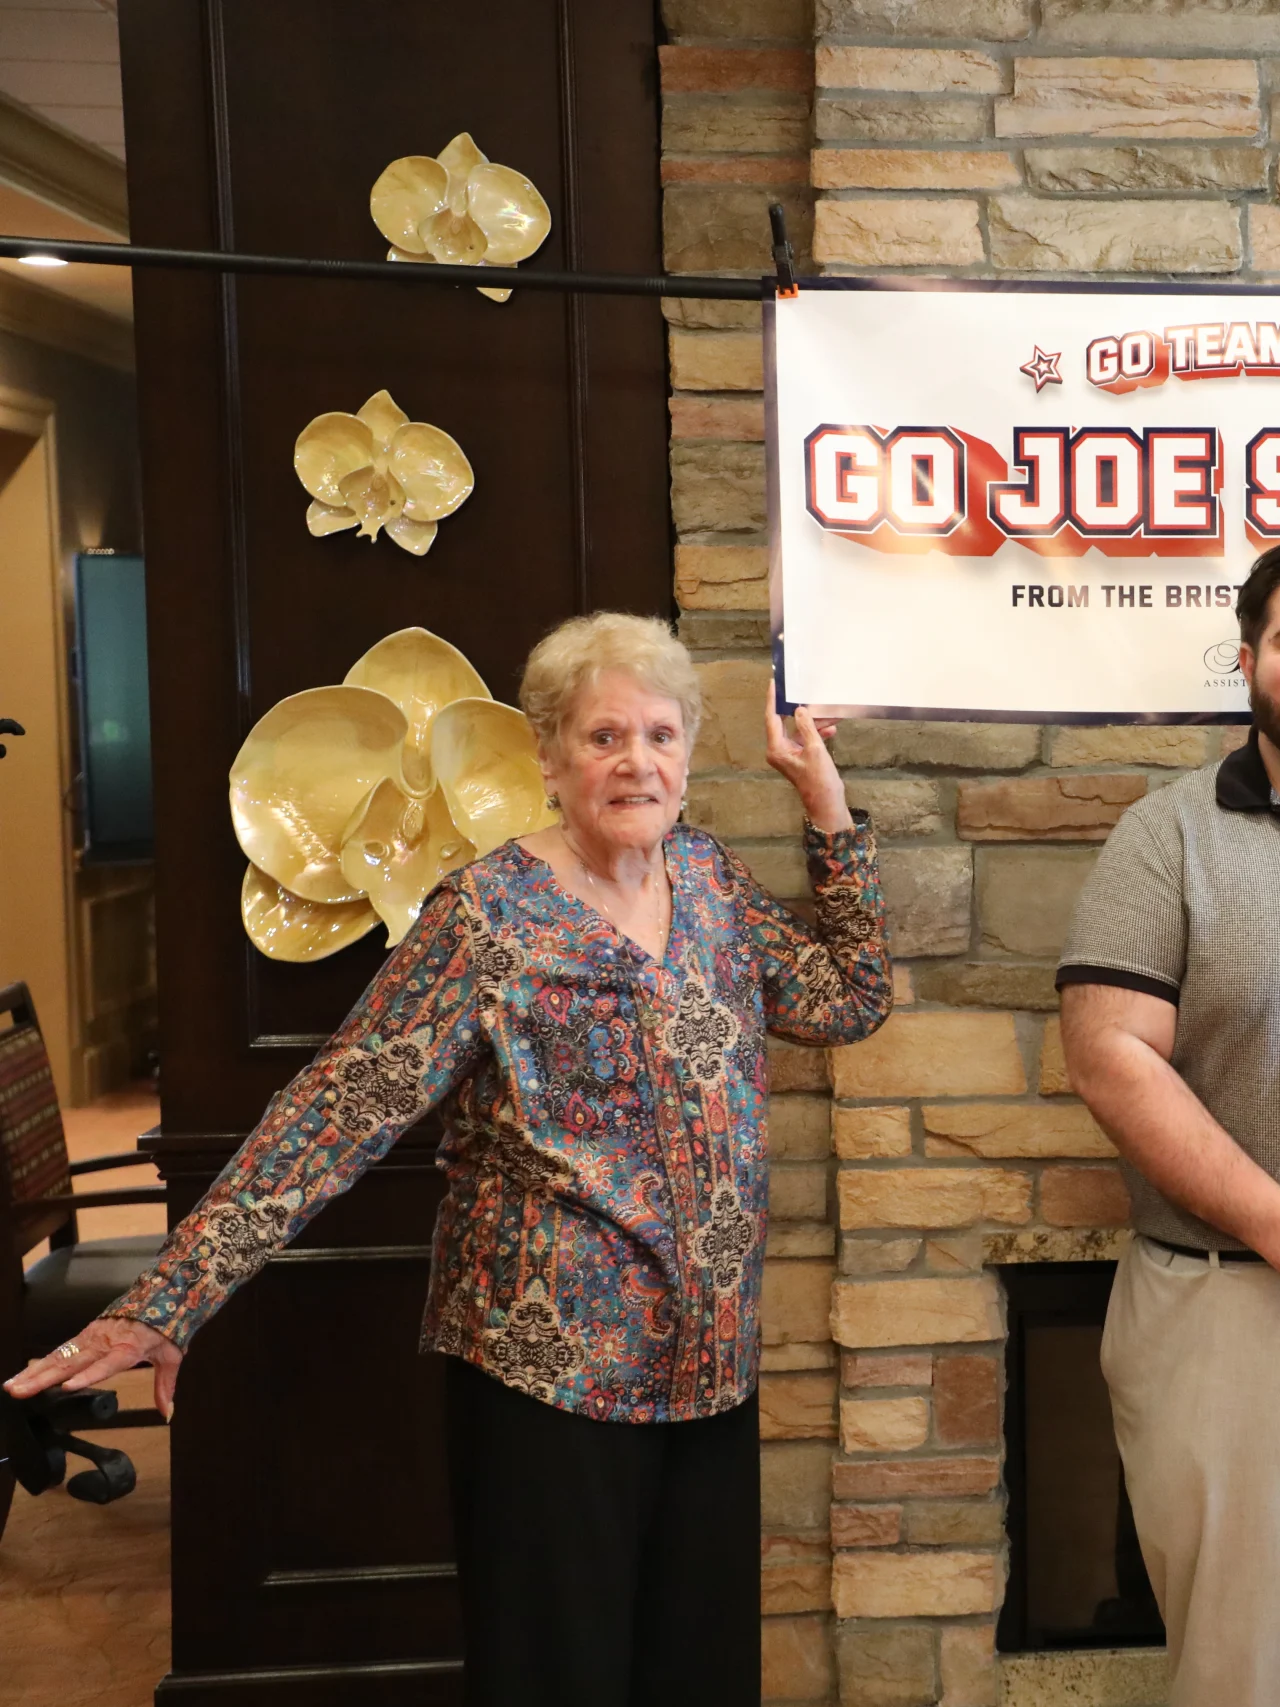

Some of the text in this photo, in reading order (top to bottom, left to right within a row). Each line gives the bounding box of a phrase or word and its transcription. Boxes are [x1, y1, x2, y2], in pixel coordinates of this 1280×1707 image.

[1085, 329, 1160, 391] GO
[803, 422, 980, 546] GO
[986, 425, 1224, 548] JOE
[1012, 584, 1089, 608] FROM
[1100, 584, 1153, 608] THE
